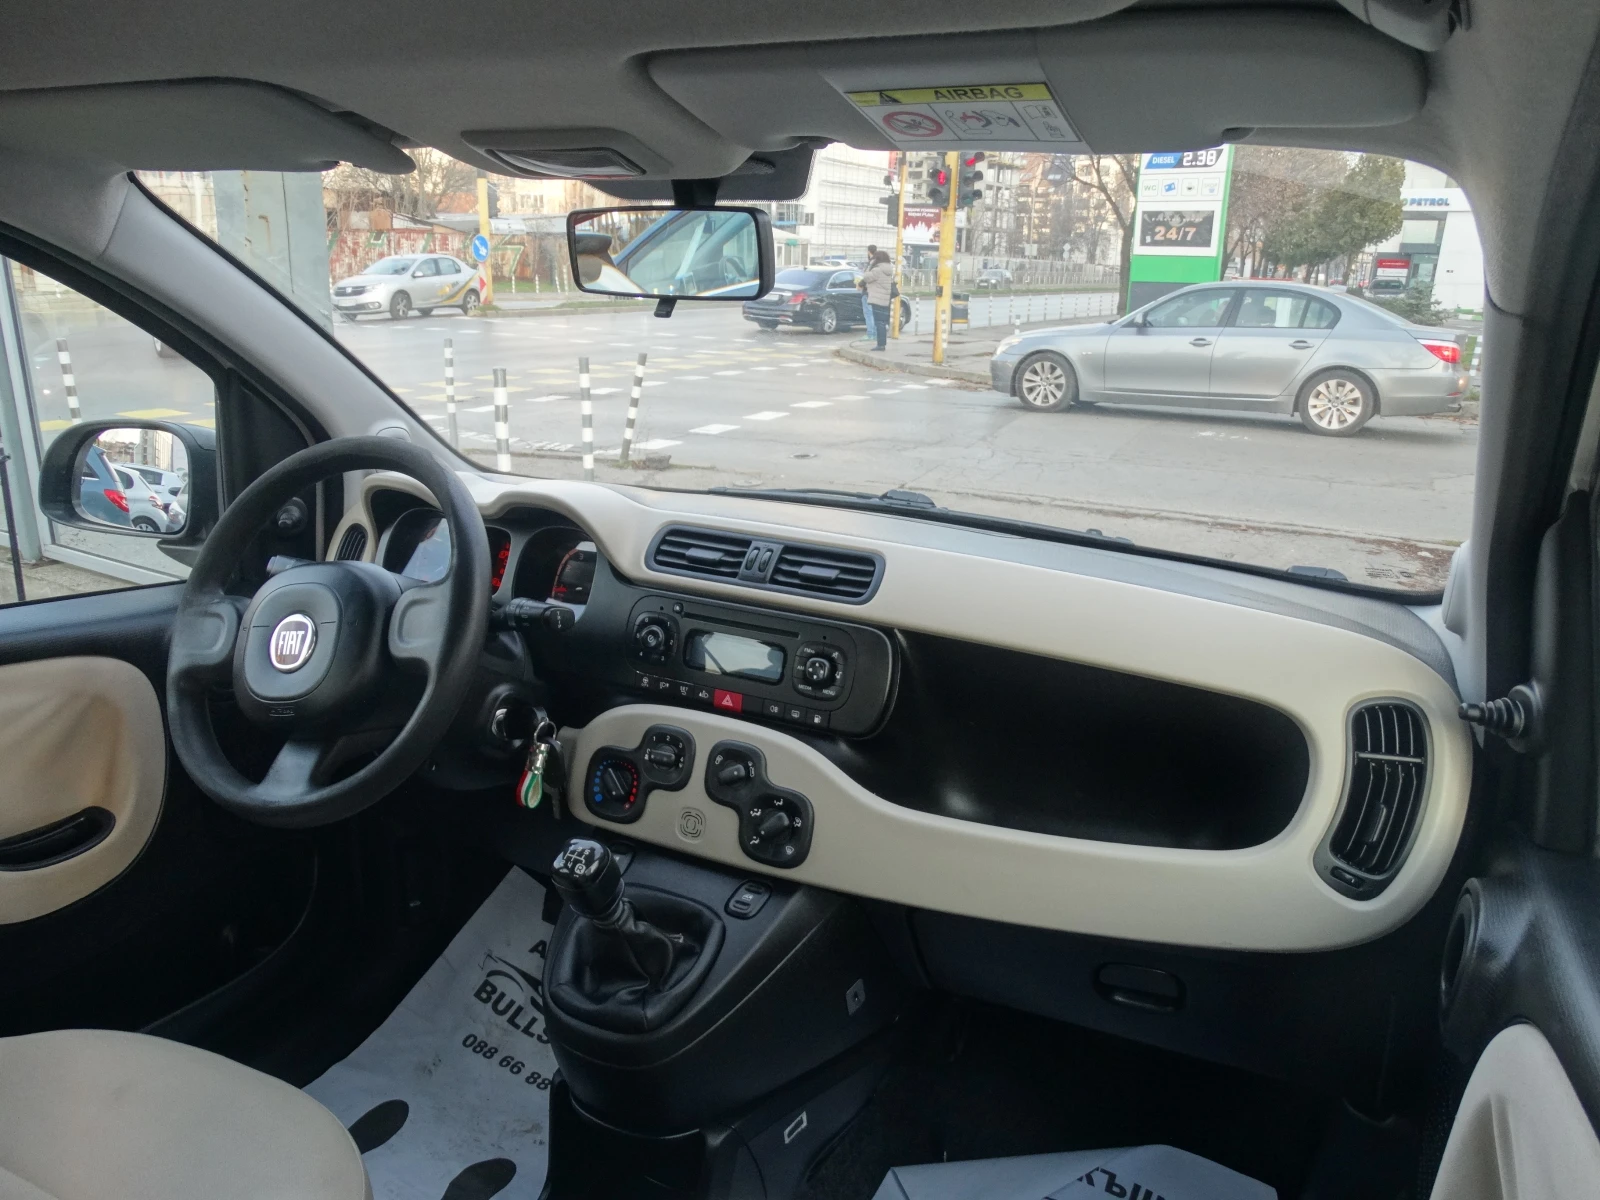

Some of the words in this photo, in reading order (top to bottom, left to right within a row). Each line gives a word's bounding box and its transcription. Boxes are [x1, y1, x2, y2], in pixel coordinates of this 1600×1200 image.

[933, 87, 1024, 100] AIRBAG
[1152, 156, 1175, 164] DIESEL
[1182, 150, 1217, 166] 2.38
[1409, 198, 1450, 206] PETROL
[1153, 225, 1197, 241] 24/7
[278, 630, 306, 655] FIAT
[462, 1033, 499, 1060] 088
[498, 1055, 526, 1075] 66
[524, 1071, 552, 1091] 88
